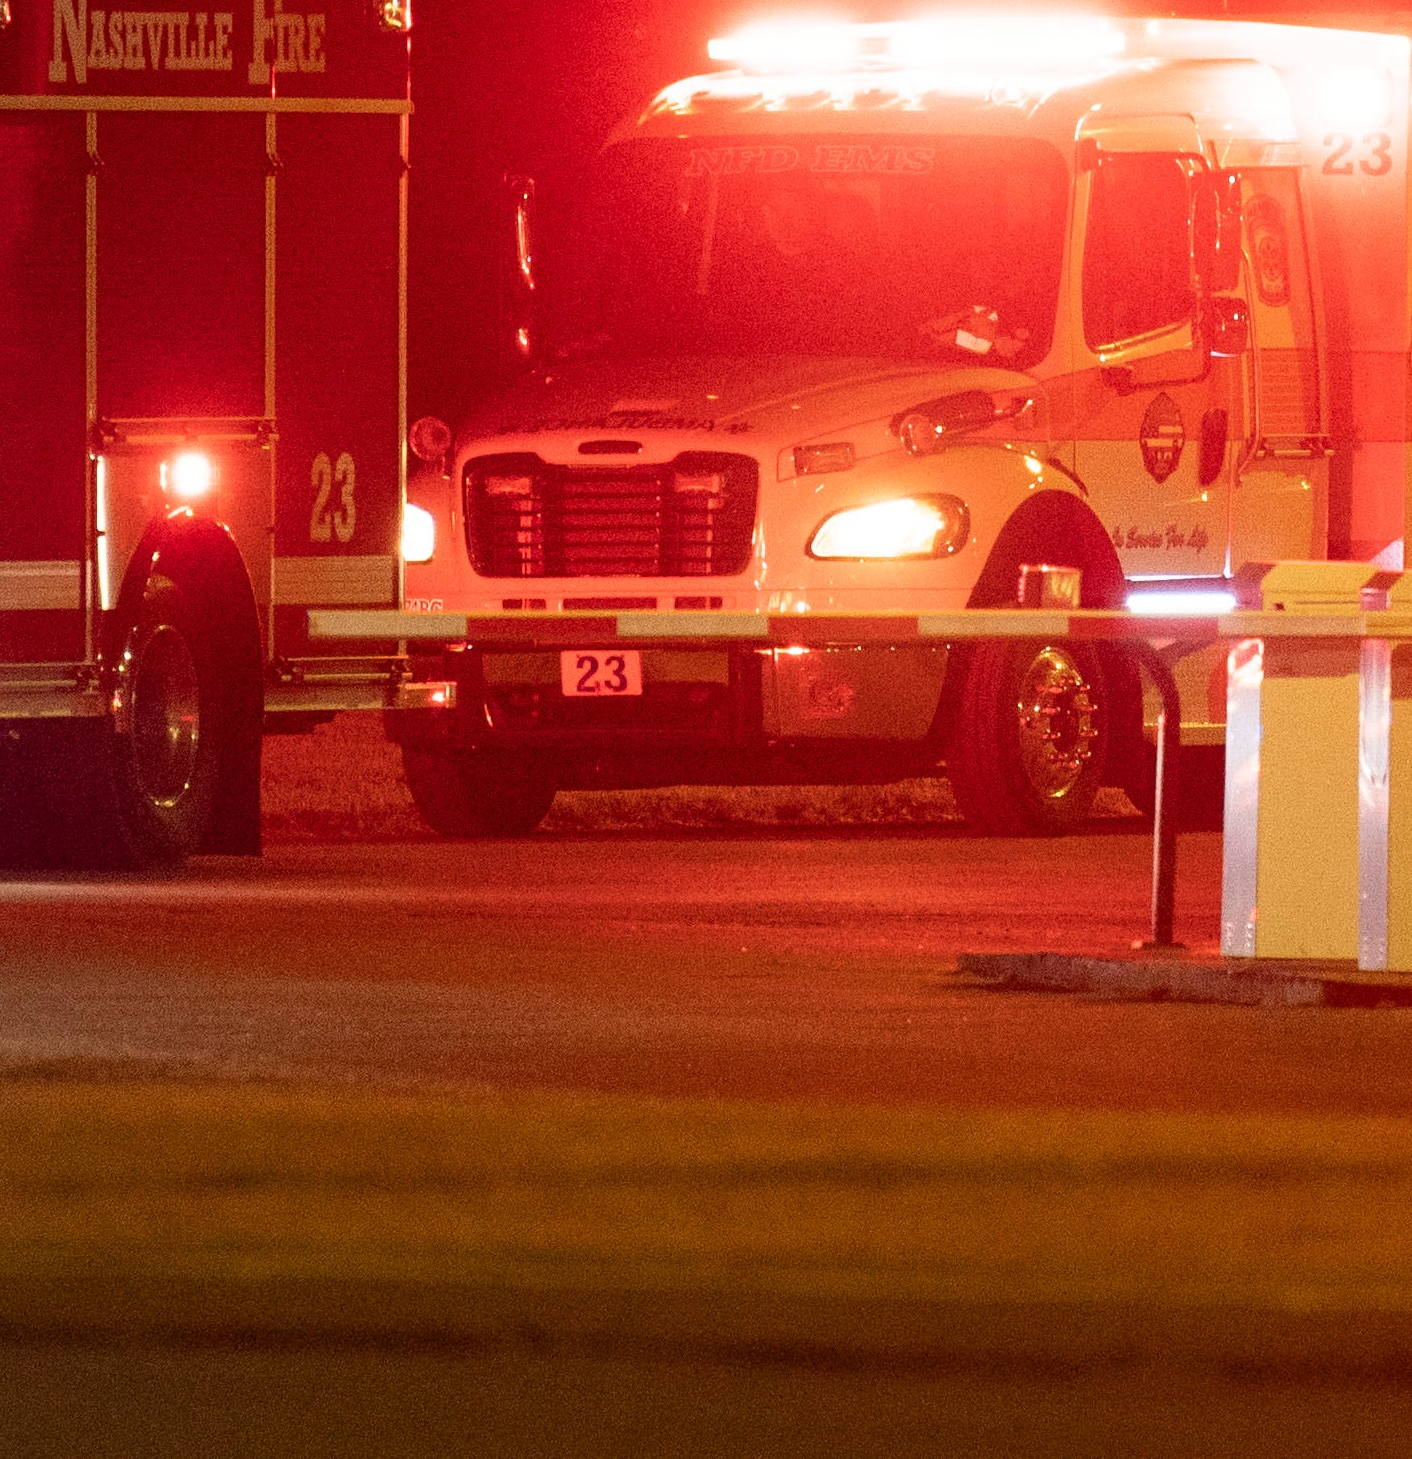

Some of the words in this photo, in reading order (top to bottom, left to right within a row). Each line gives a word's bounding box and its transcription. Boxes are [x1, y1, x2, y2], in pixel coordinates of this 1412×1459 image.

[684, 144, 799, 177] NFD
[809, 144, 936, 174] EMS
[1321, 131, 1393, 176] 23
[310, 450, 356, 543] 23
[576, 655, 628, 692] 23
